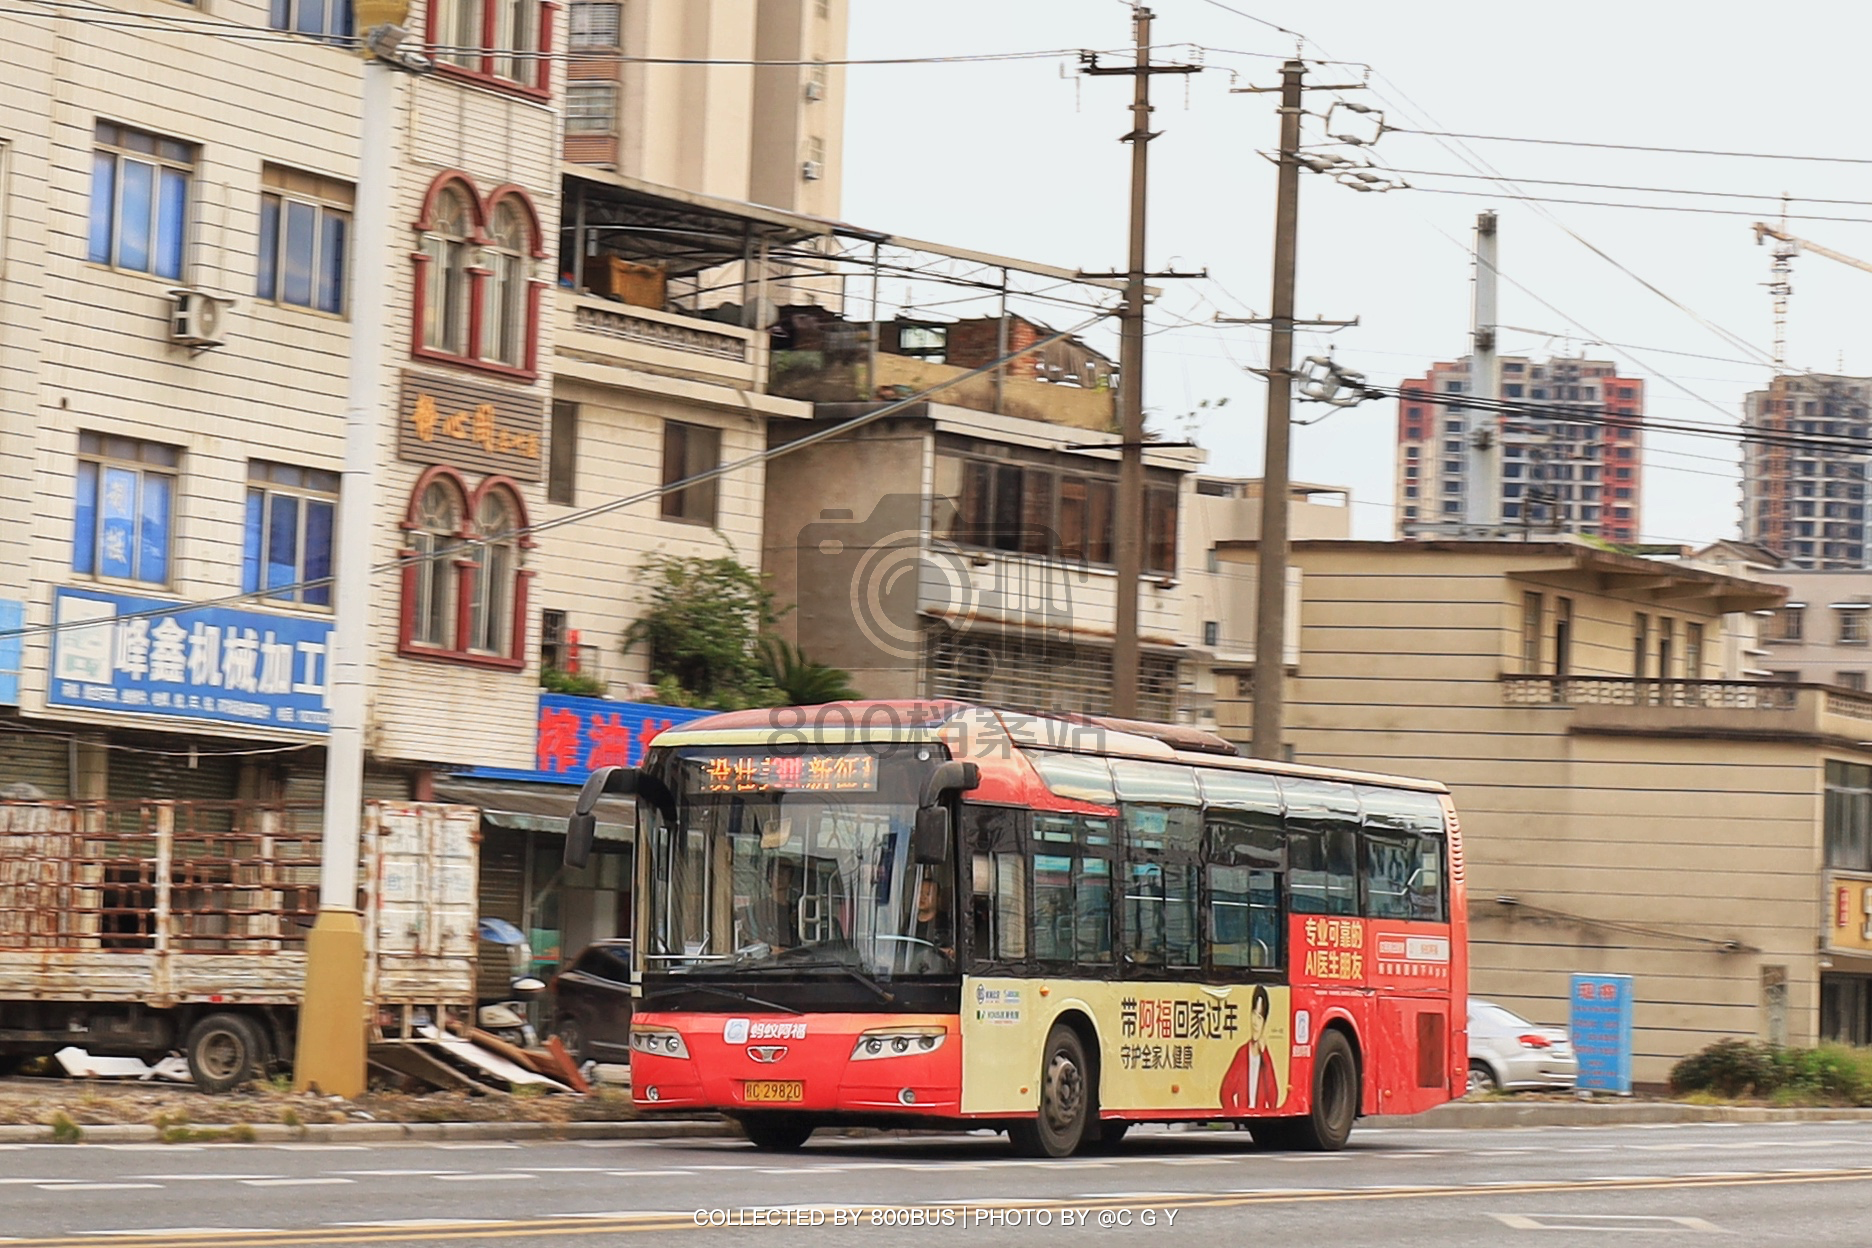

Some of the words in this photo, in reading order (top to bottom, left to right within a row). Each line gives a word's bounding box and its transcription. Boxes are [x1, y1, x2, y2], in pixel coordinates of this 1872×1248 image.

[115, 617, 336, 708] 峰鑫机械加工
[1305, 917, 1364, 949] 专业可靠的
[1304, 950, 1364, 980] AI医生朋友
[749, 1023, 807, 1039] 蚂蚁阿福
[1121, 997, 1238, 1039] 带阿福回家过年
[1120, 1045, 1193, 1069] 守护全家人健康
